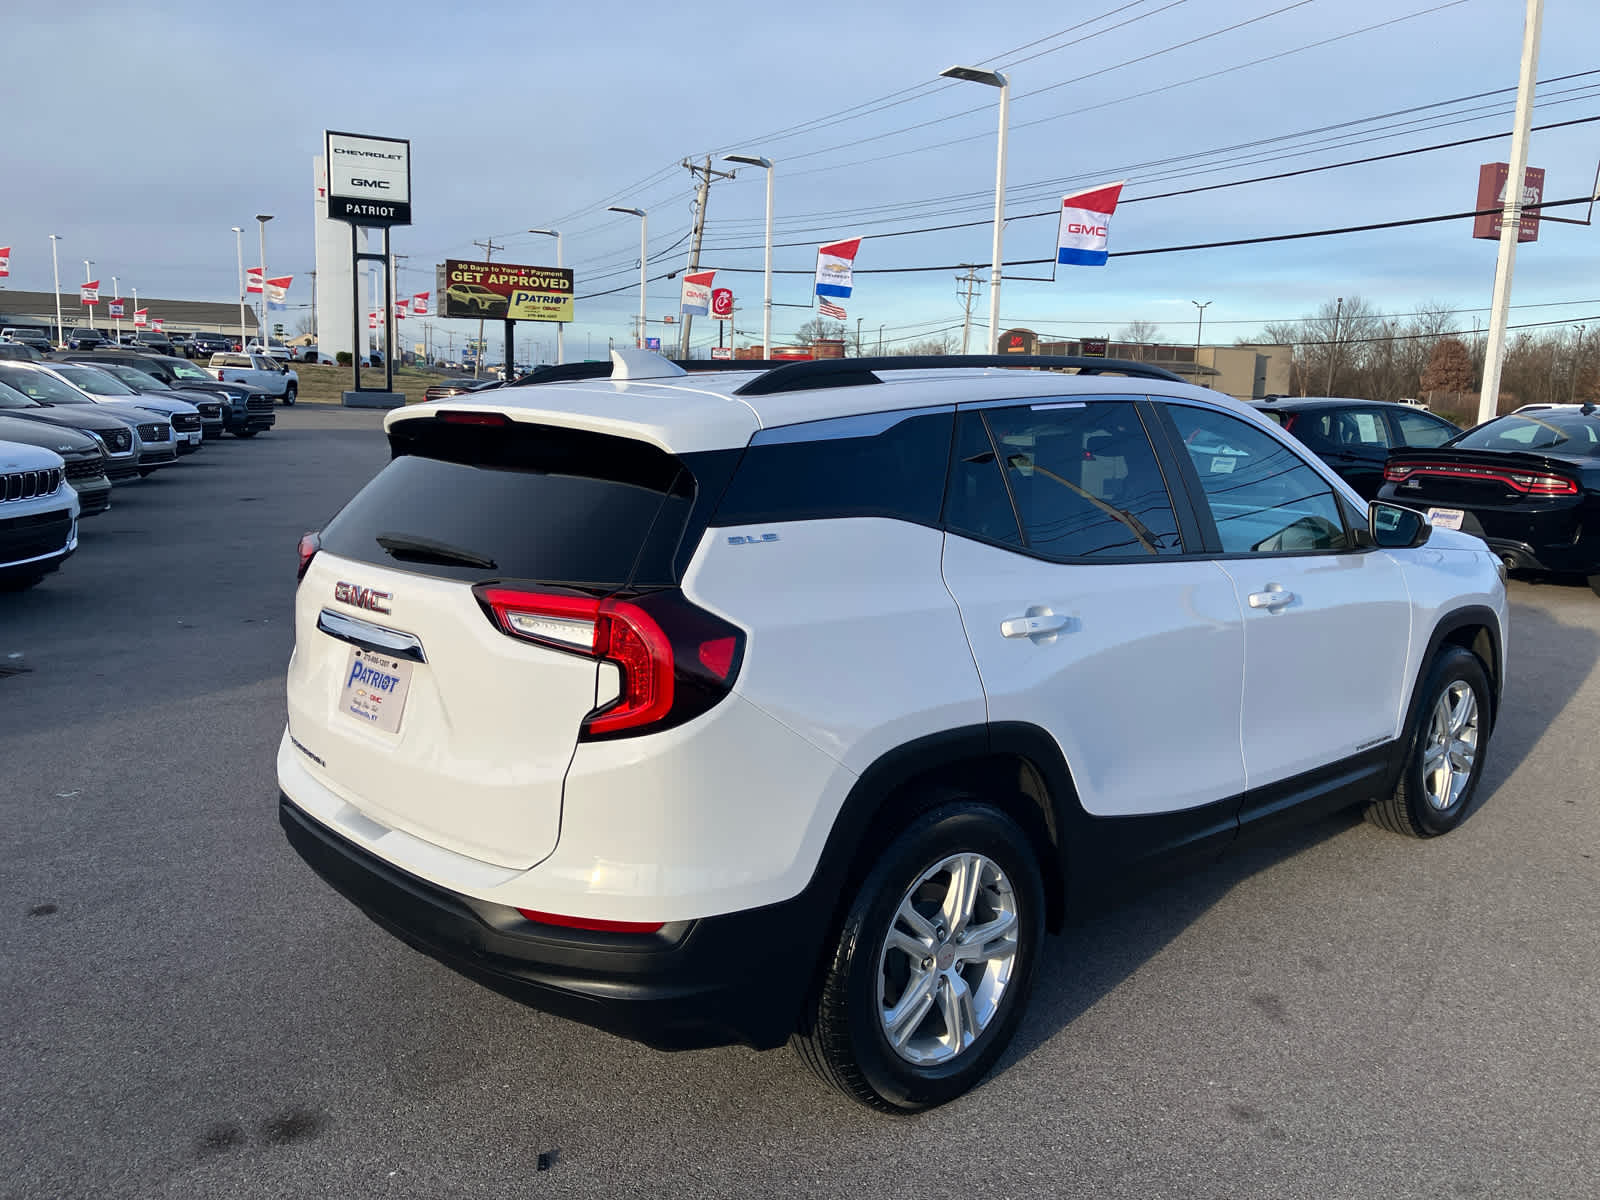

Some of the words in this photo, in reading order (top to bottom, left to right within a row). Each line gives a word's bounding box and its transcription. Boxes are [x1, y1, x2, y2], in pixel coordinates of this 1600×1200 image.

[334, 148, 403, 160] CHEVROLET
[351, 177, 390, 189] GMC
[346, 203, 395, 217] PATRIOT
[1068, 223, 1107, 237] GMC
[451, 271, 484, 283] GET
[488, 274, 569, 289] APPROVED
[515, 292, 568, 306] PATRIOT
[728, 533, 777, 545] SLE
[335, 581, 393, 615] GMC
[347, 660, 400, 693] PATRIOT
